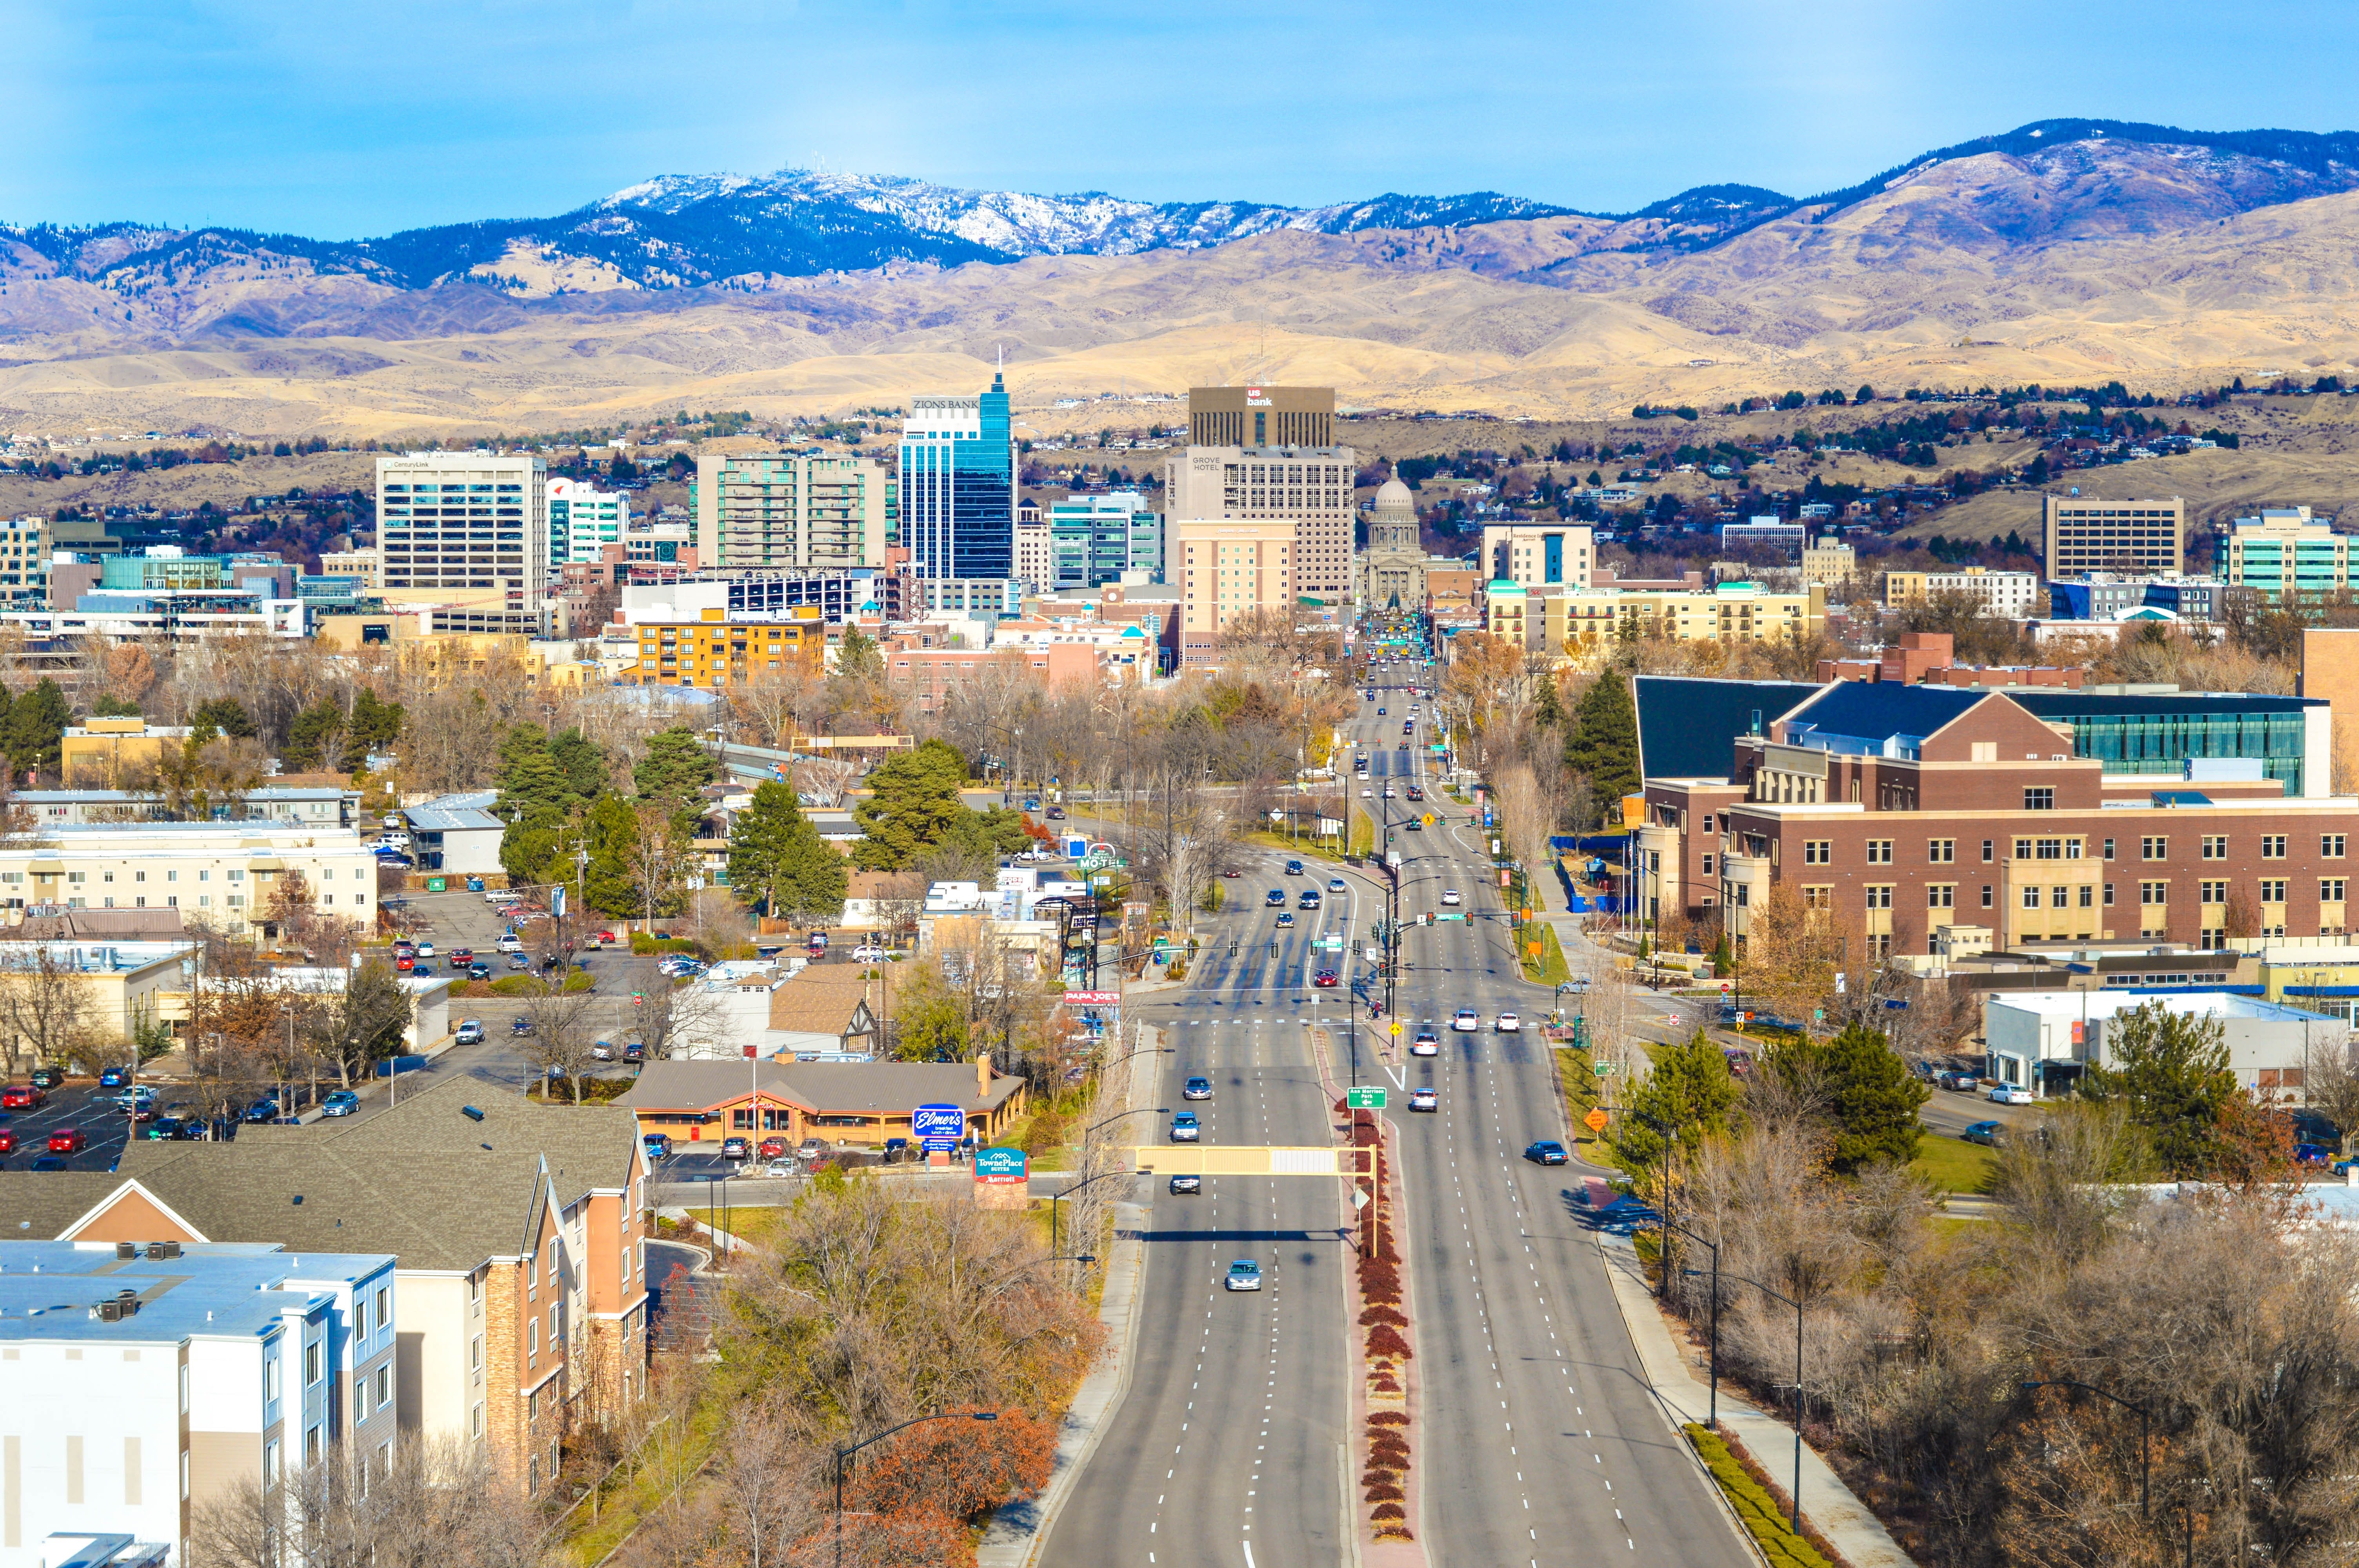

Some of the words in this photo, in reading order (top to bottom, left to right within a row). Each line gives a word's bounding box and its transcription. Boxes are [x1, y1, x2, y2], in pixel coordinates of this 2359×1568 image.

[1247, 397, 1272, 406] bank
[1092, 993, 1120, 1001] JOE'S
[916, 1112, 960, 1129] Elmer's
